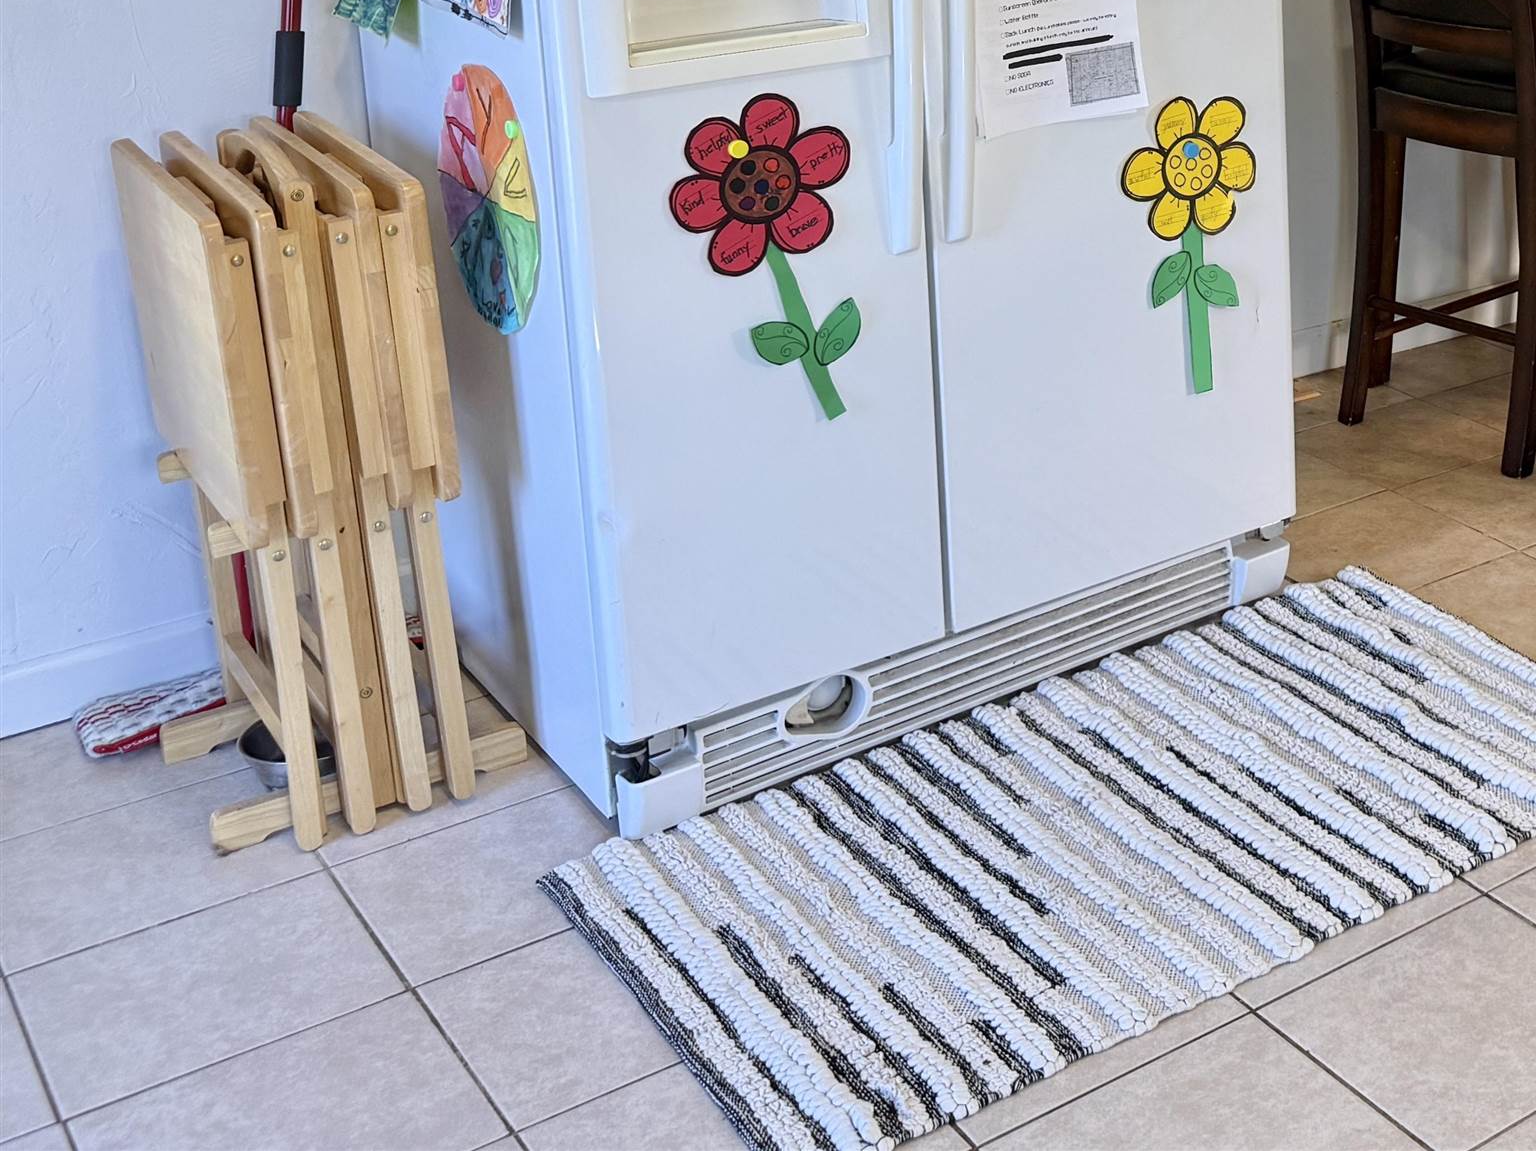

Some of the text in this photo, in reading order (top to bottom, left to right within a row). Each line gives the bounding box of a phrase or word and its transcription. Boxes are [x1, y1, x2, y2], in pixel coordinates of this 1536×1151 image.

[755, 107, 789, 134] sweet
[695, 129, 733, 160] helpful
[809, 143, 845, 171] pretty
[788, 217, 819, 239] brave
[721, 242, 751, 265] funny
